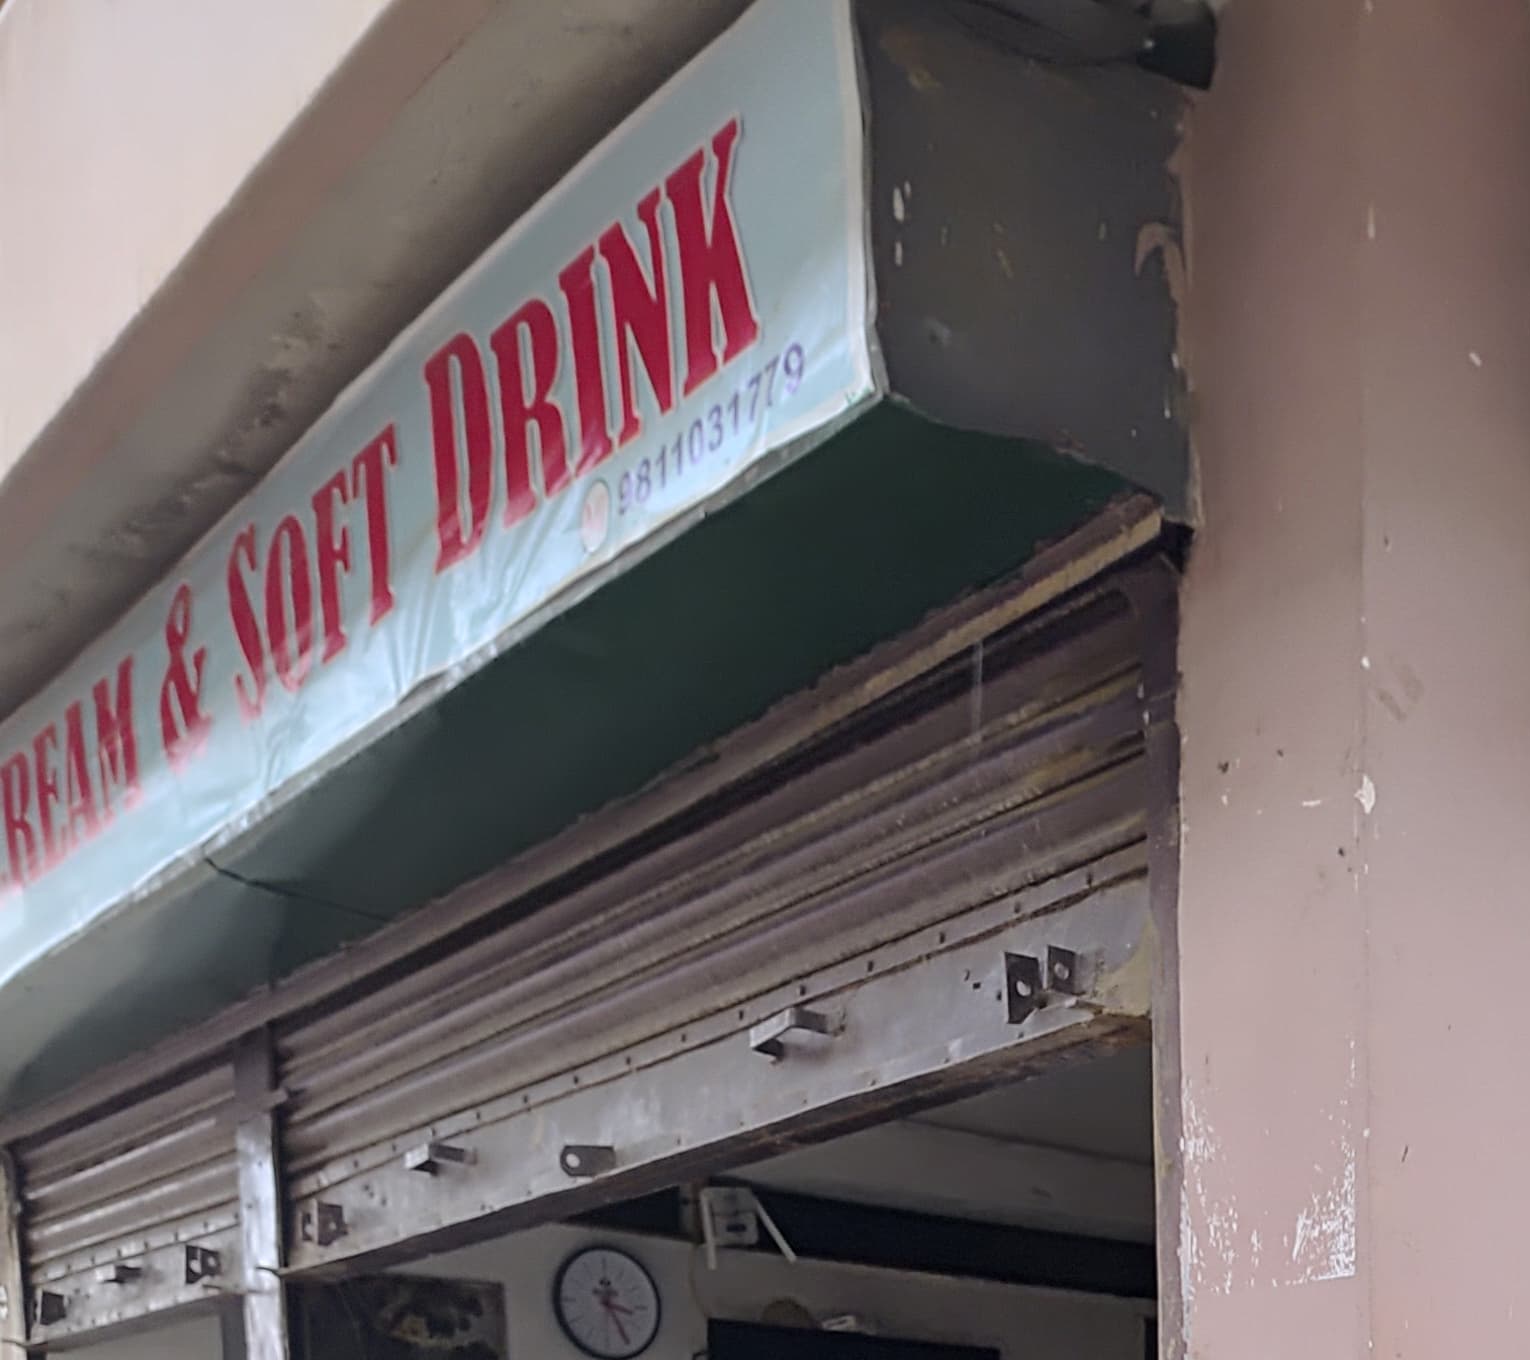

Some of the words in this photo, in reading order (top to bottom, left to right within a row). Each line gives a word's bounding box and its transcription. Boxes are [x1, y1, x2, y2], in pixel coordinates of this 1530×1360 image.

[0, 654, 143, 888] REAM
[160, 583, 212, 775] &
[226, 424, 398, 722] SOFT
[423, 115, 759, 573] DRINK
[618, 343, 805, 516] 9811031779
